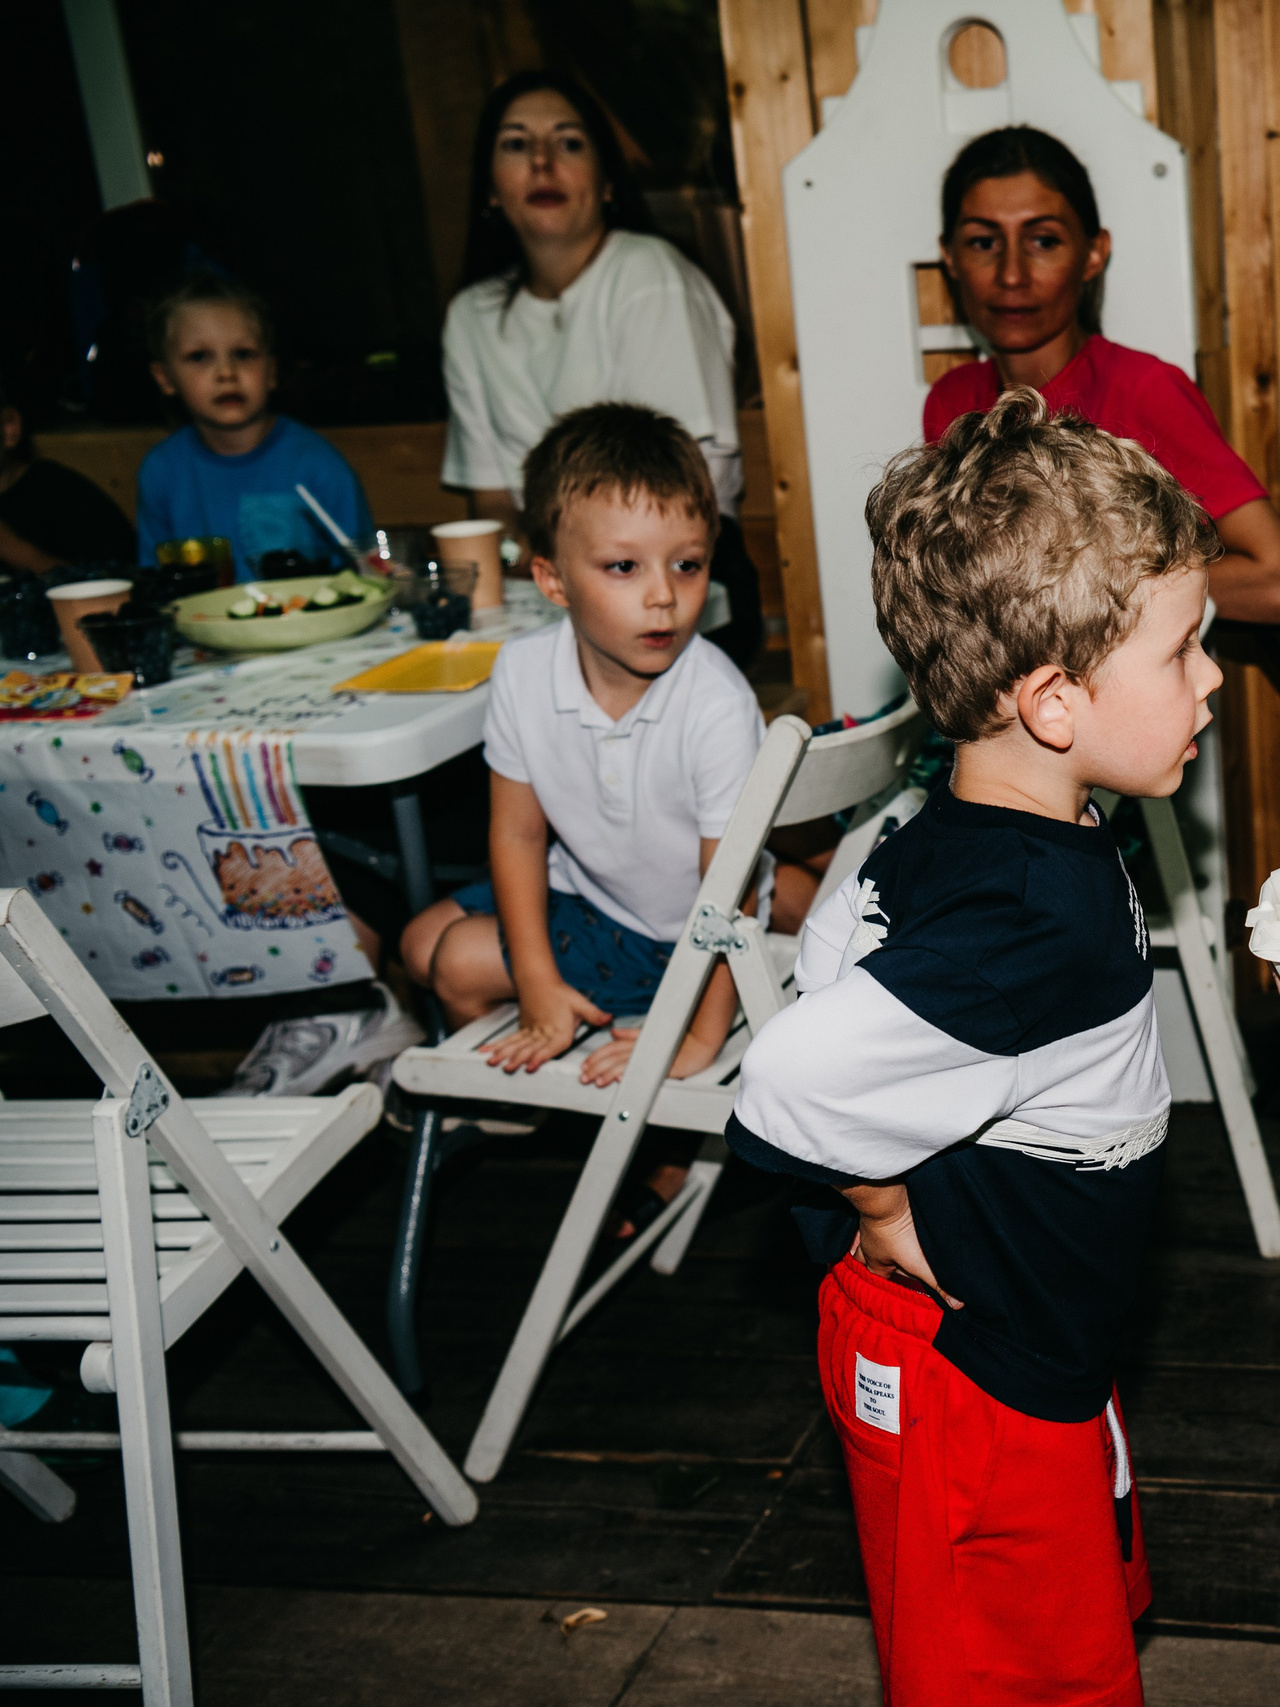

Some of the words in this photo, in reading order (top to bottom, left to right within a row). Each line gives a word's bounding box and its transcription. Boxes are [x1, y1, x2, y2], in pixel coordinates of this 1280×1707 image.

[867, 1378, 882, 1387] VOICE
[874, 1390, 894, 1398] SPEAKS
[873, 1407, 886, 1415] SOUL
